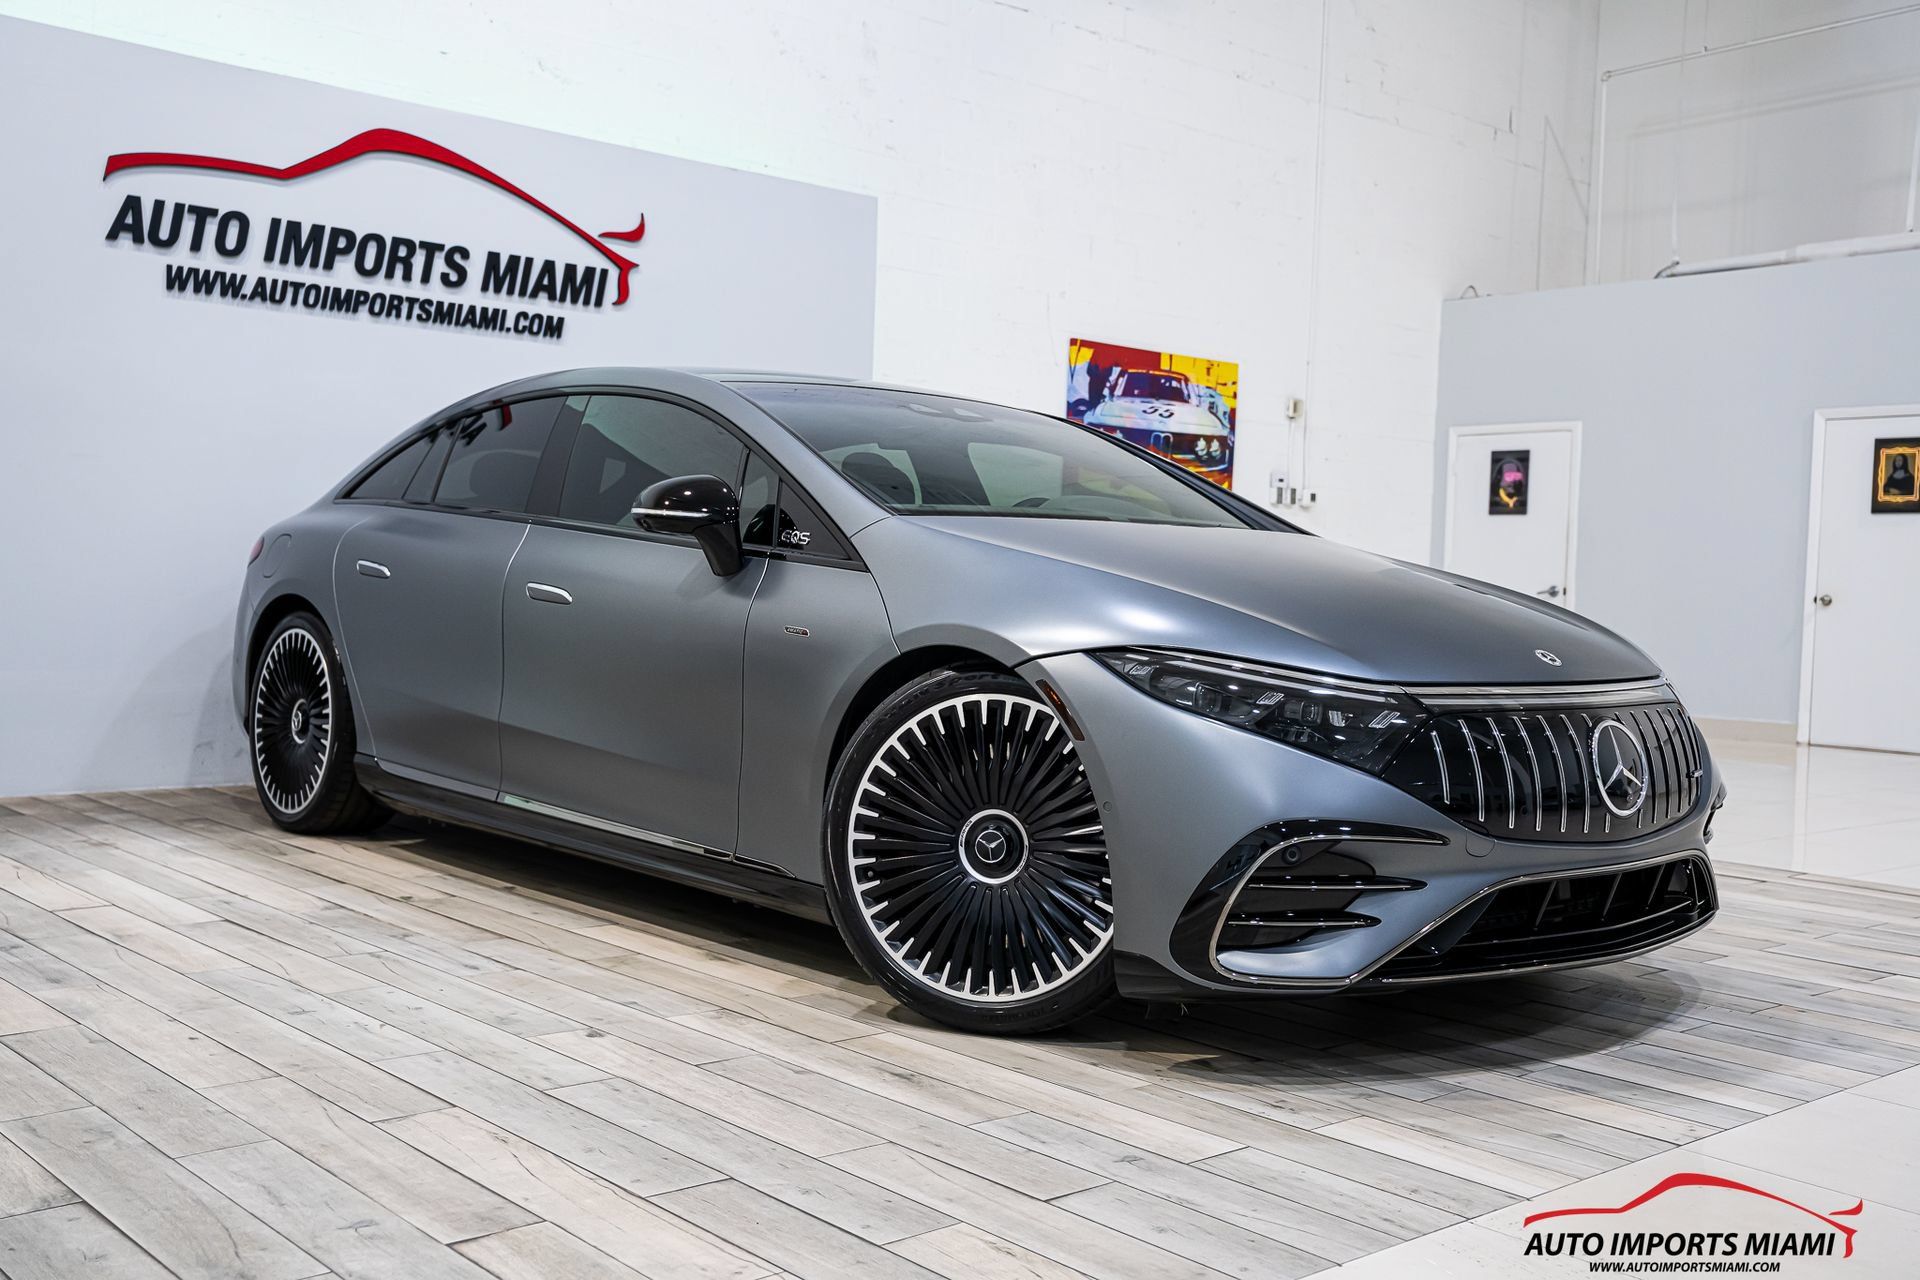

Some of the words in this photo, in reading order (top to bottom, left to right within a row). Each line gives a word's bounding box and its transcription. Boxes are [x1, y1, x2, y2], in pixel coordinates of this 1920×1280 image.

[105, 195, 249, 257] AUTO
[263, 217, 470, 288] IMPORTS
[480, 251, 609, 308] MIAMI
[165, 264, 565, 339] WWW.AUTOIMPORTSMIAMI.COM
[781, 529, 811, 545] EQS
